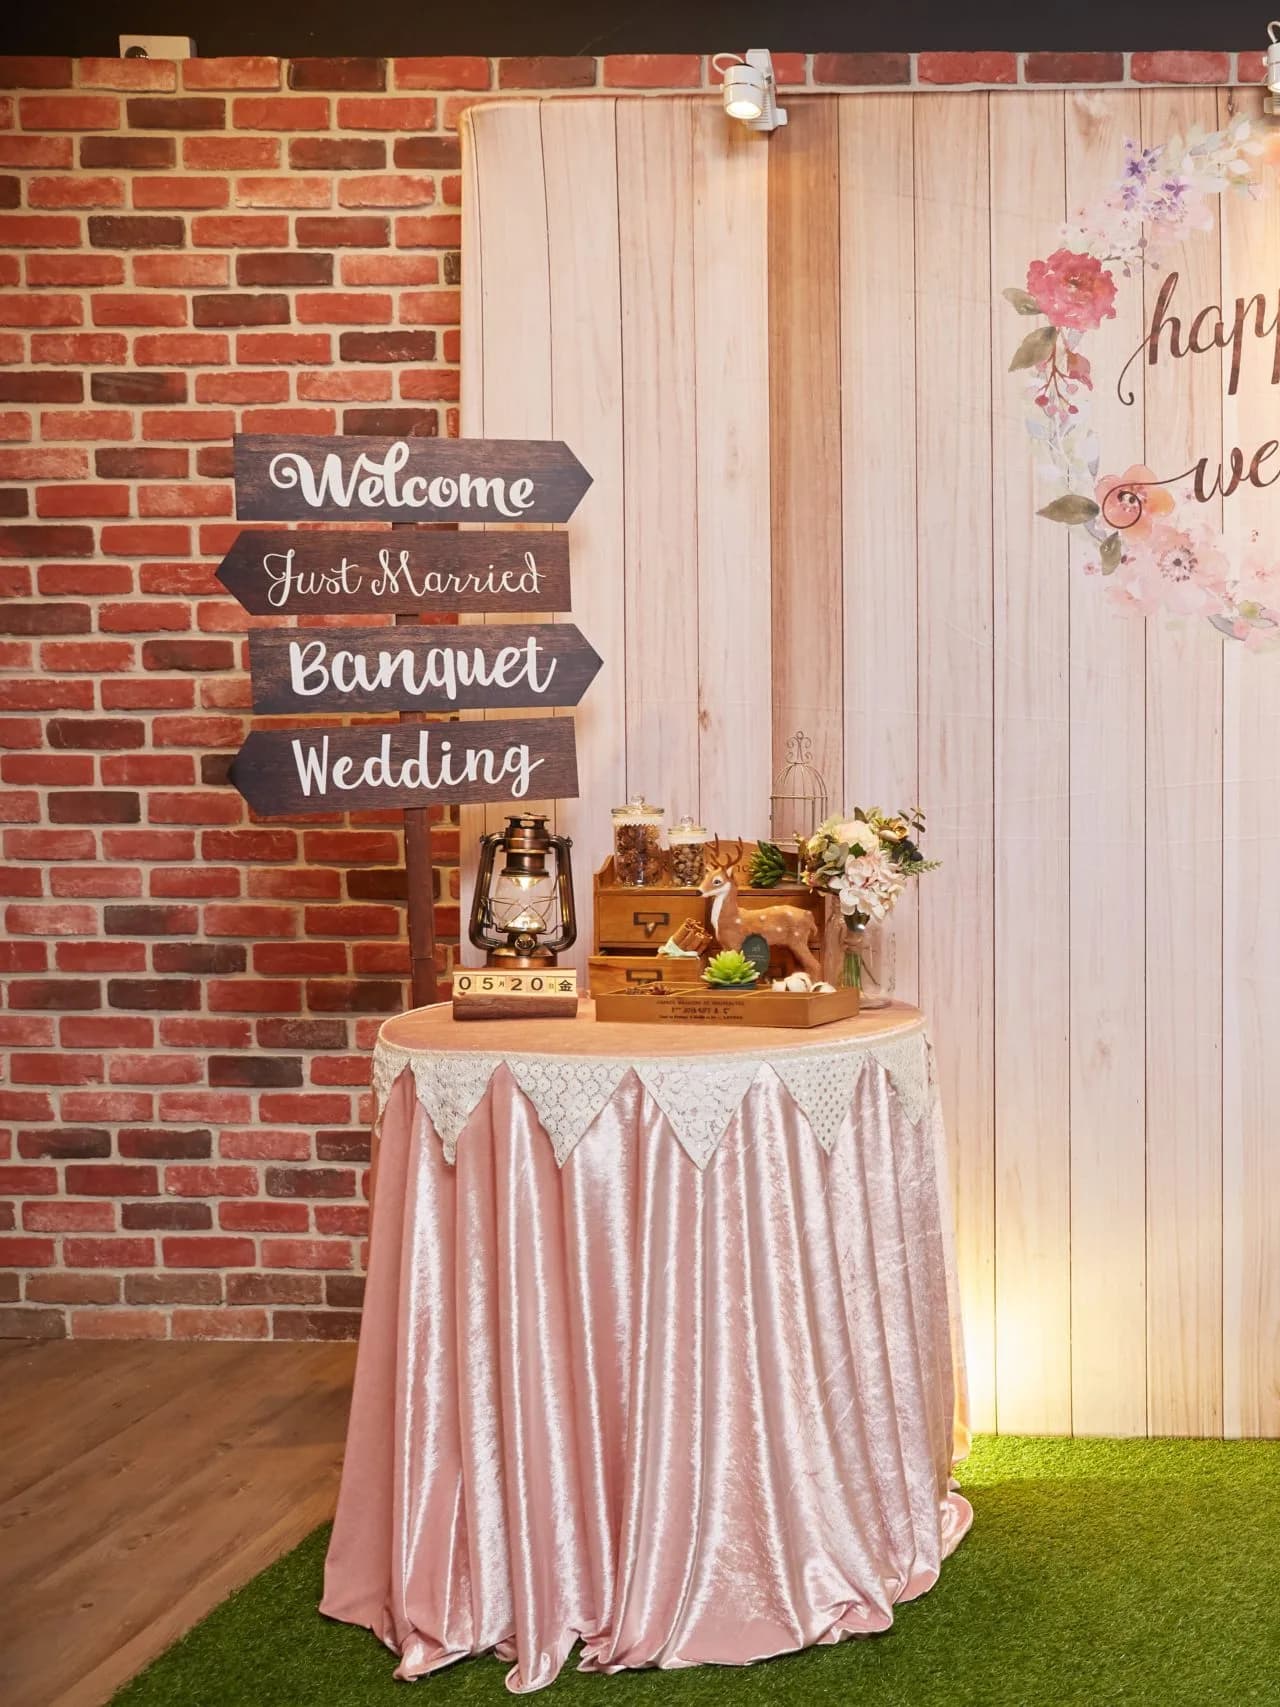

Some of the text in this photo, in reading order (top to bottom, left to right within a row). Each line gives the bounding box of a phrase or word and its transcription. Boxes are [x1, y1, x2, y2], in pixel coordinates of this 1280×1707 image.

[268, 440, 536, 518] Welcome
[263, 548, 547, 608] Just Married
[288, 635, 558, 701] Banquet
[291, 729, 546, 798] Wedding
